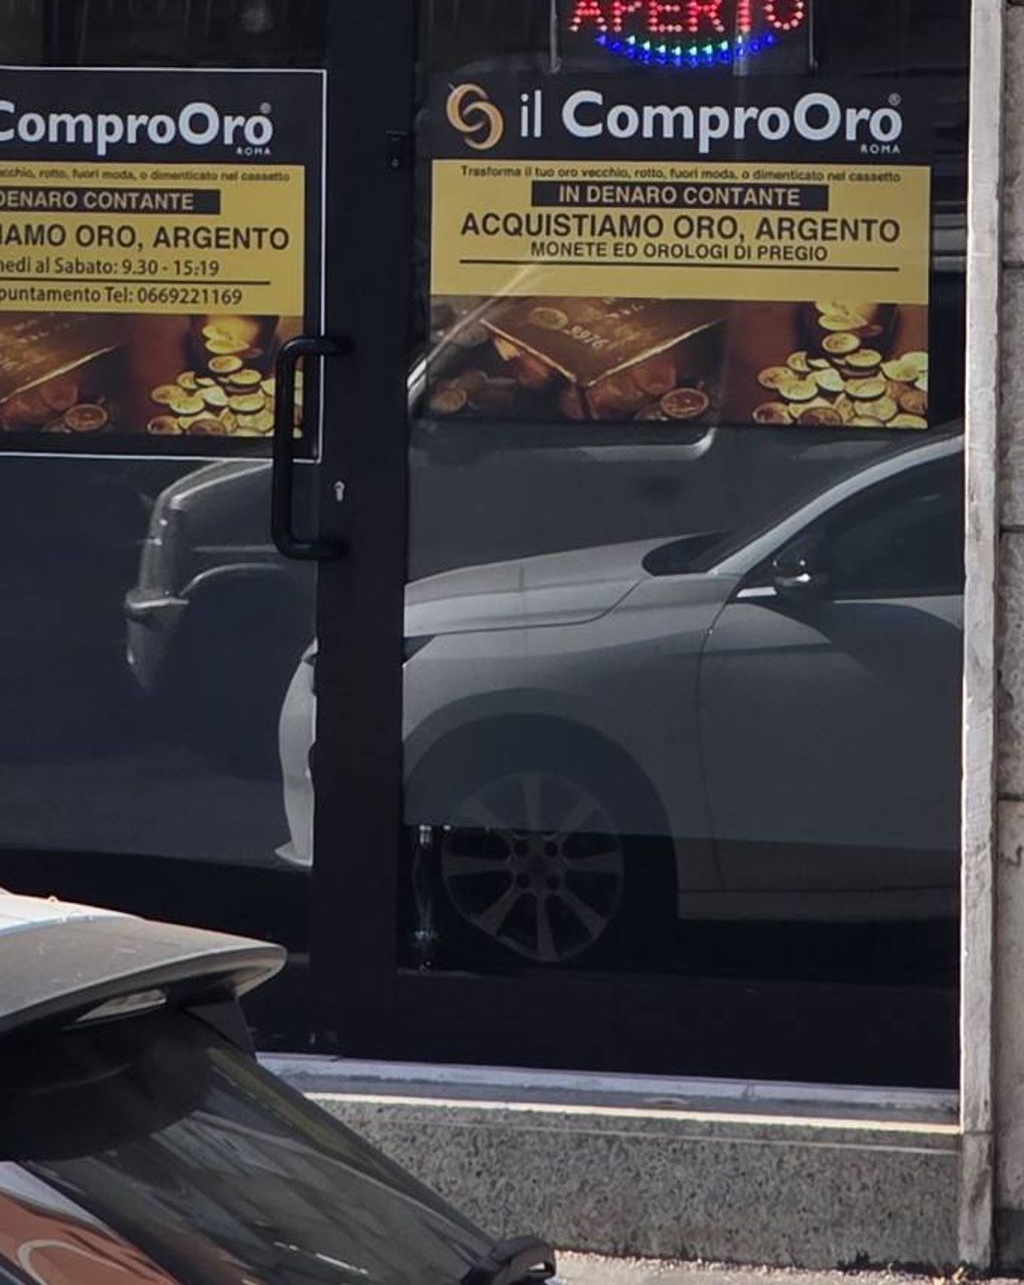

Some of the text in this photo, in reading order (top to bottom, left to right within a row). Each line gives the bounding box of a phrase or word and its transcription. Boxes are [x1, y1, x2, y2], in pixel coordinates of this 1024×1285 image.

[520, 89, 903, 153] il ComproOro
[236, 146, 272, 156] ROMA
[860, 144, 900, 154] ROMA
[72, 169, 99, 180] fuori
[102, 169, 137, 181] moda,
[139, 171, 147, 180] o
[150, 170, 218, 181] dimenticato
[221, 171, 238, 181] nel
[240, 171, 290, 182] cassetto
[460, 165, 902, 182] Trasforma il tuo oro vecchio, rotto, fuori moda, o dimenticato nel cassetto
[83, 191, 195, 211] CONTANTE
[558, 184, 801, 207] IN DENARO CONTANTE
[75, 224, 144, 251] ORO,
[152, 226, 290, 250] ARGENTO
[460, 211, 901, 244] ACQUISTIAMO ORO, ARGENTO
[530, 241, 828, 261] MONETE ED OROLOGI DI PREGIO
[35, 257, 50, 274] al
[54, 256, 118, 275] Sabato:
[121, 259, 158, 276] 9.30
[105, 286, 133, 303] Tel:
[137, 288, 243, 305] 0669221169
